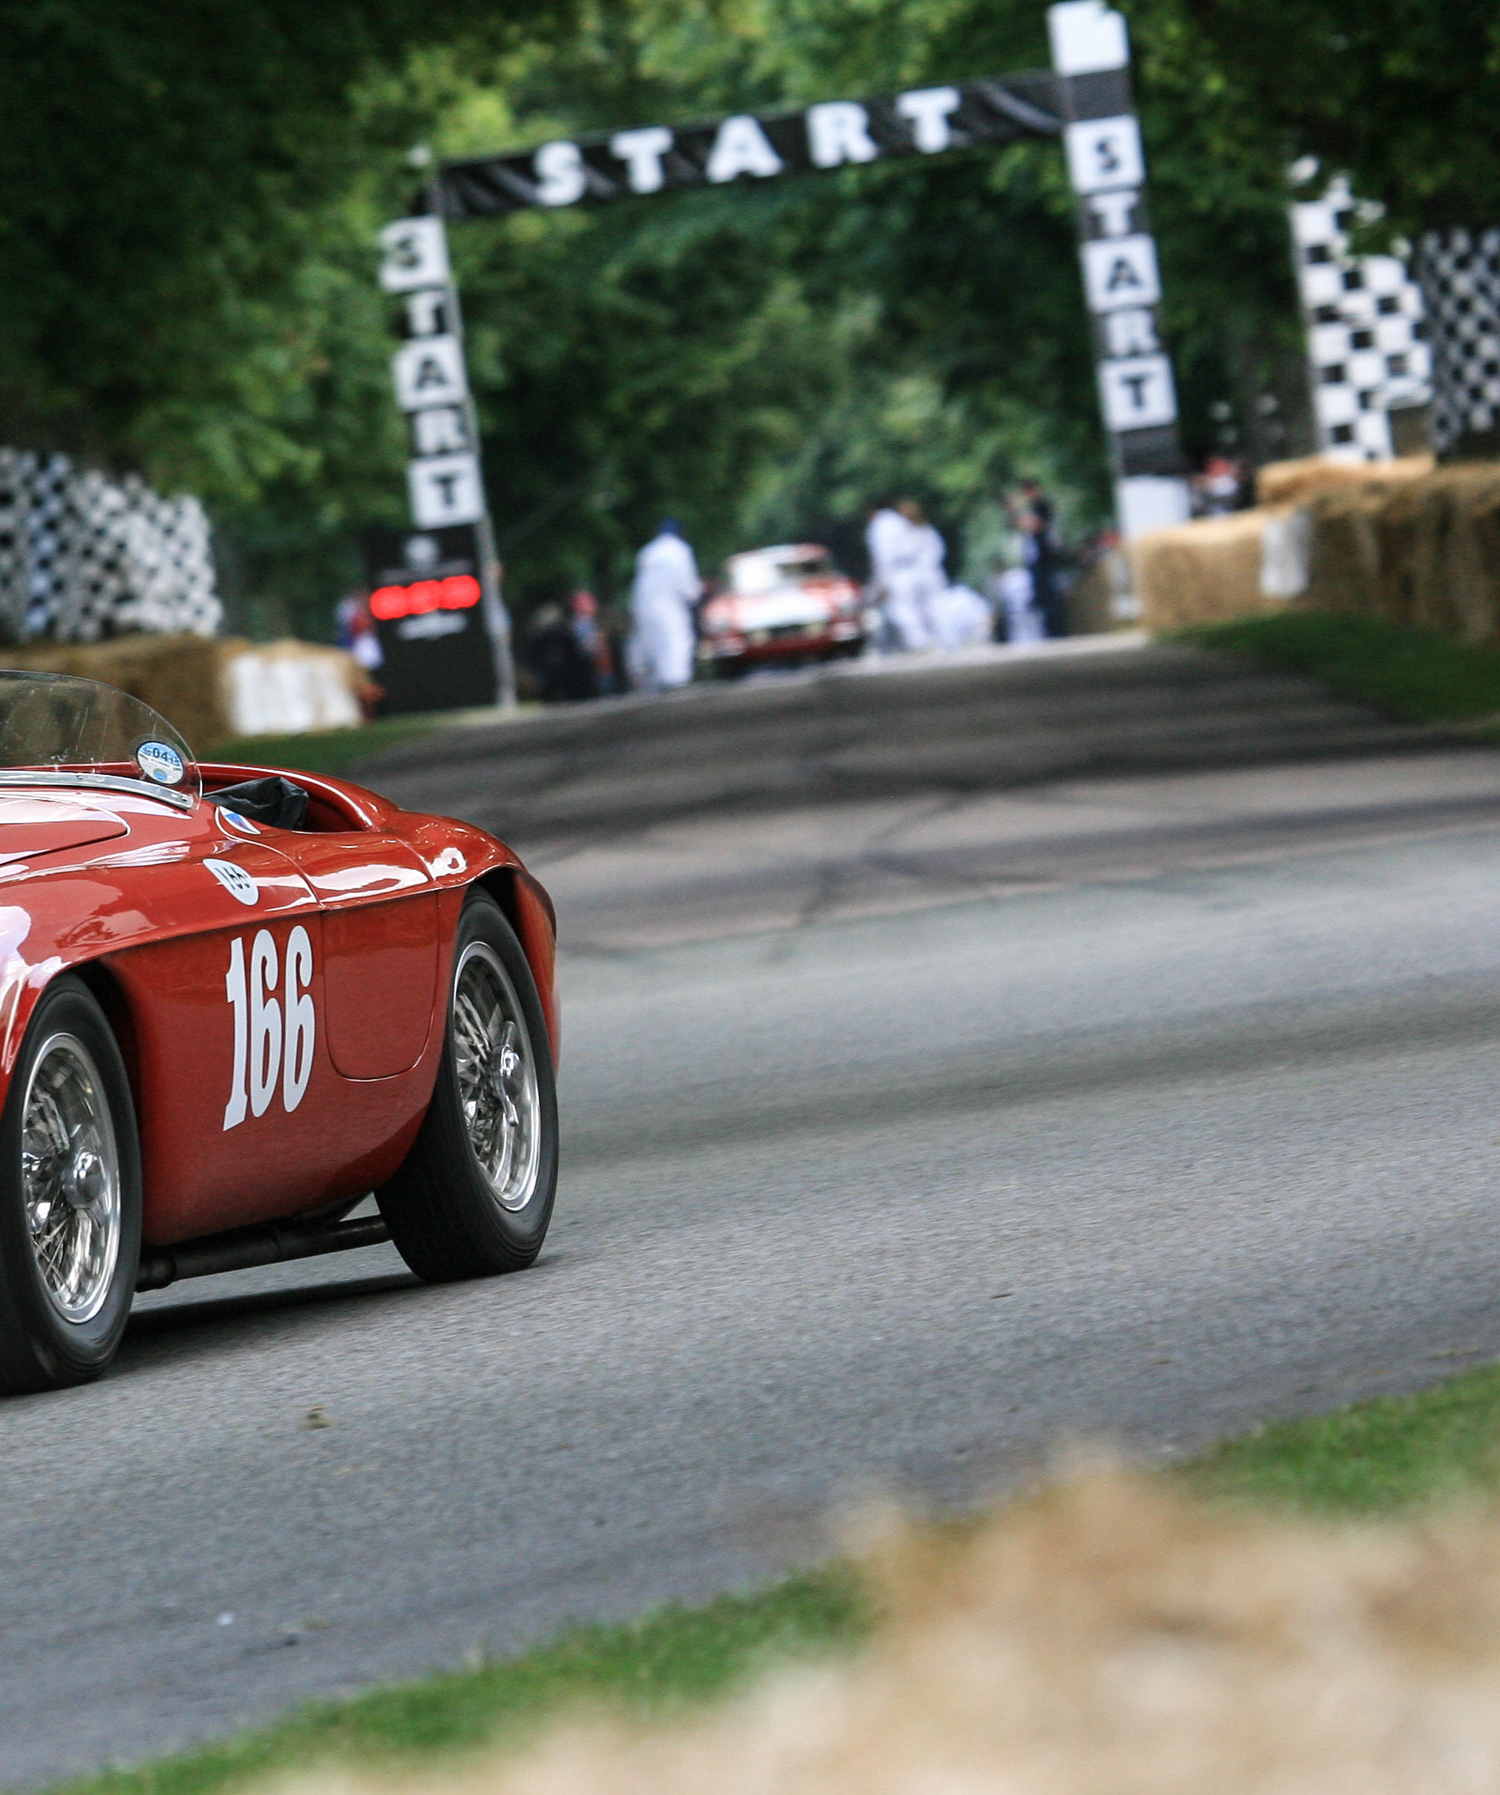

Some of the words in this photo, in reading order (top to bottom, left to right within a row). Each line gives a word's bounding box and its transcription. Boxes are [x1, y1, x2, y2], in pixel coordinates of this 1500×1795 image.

[533, 86, 961, 206] START
[1088, 136, 1160, 411] START
[391, 231, 469, 509] START
[153, 747, 168, 762] 04
[214, 866, 250, 891] 166
[223, 925, 316, 1132] 166
